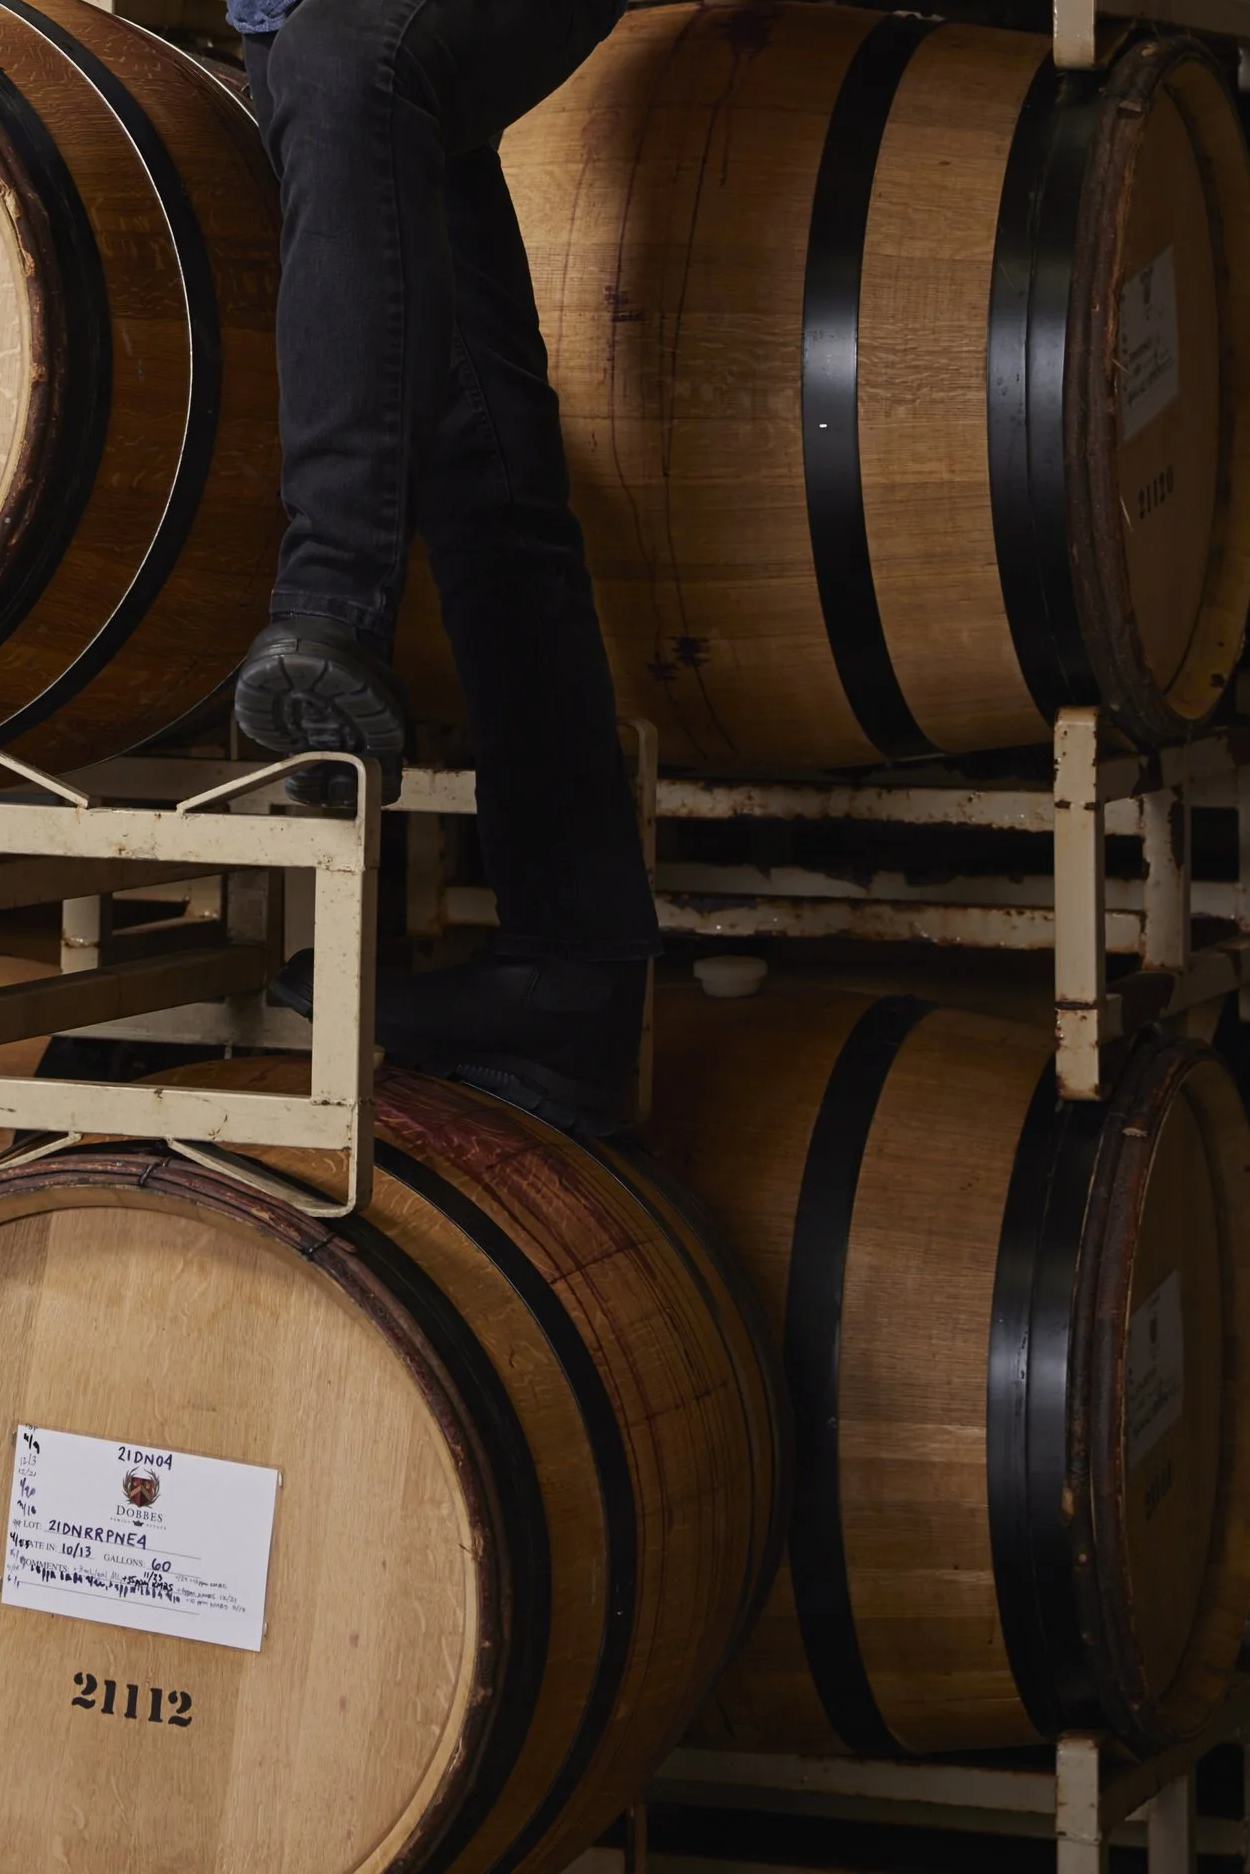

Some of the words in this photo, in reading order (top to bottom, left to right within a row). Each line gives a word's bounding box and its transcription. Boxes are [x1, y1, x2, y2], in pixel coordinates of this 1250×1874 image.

[118, 1446, 173, 1471] 21DN04
[116, 1504, 163, 1523] DOBBES
[48, 1519, 147, 1550] 21DNRRPNE4
[61, 1542, 91, 1559] 10/13
[151, 1558, 172, 1573] 60
[72, 1671, 192, 1728] 21112
